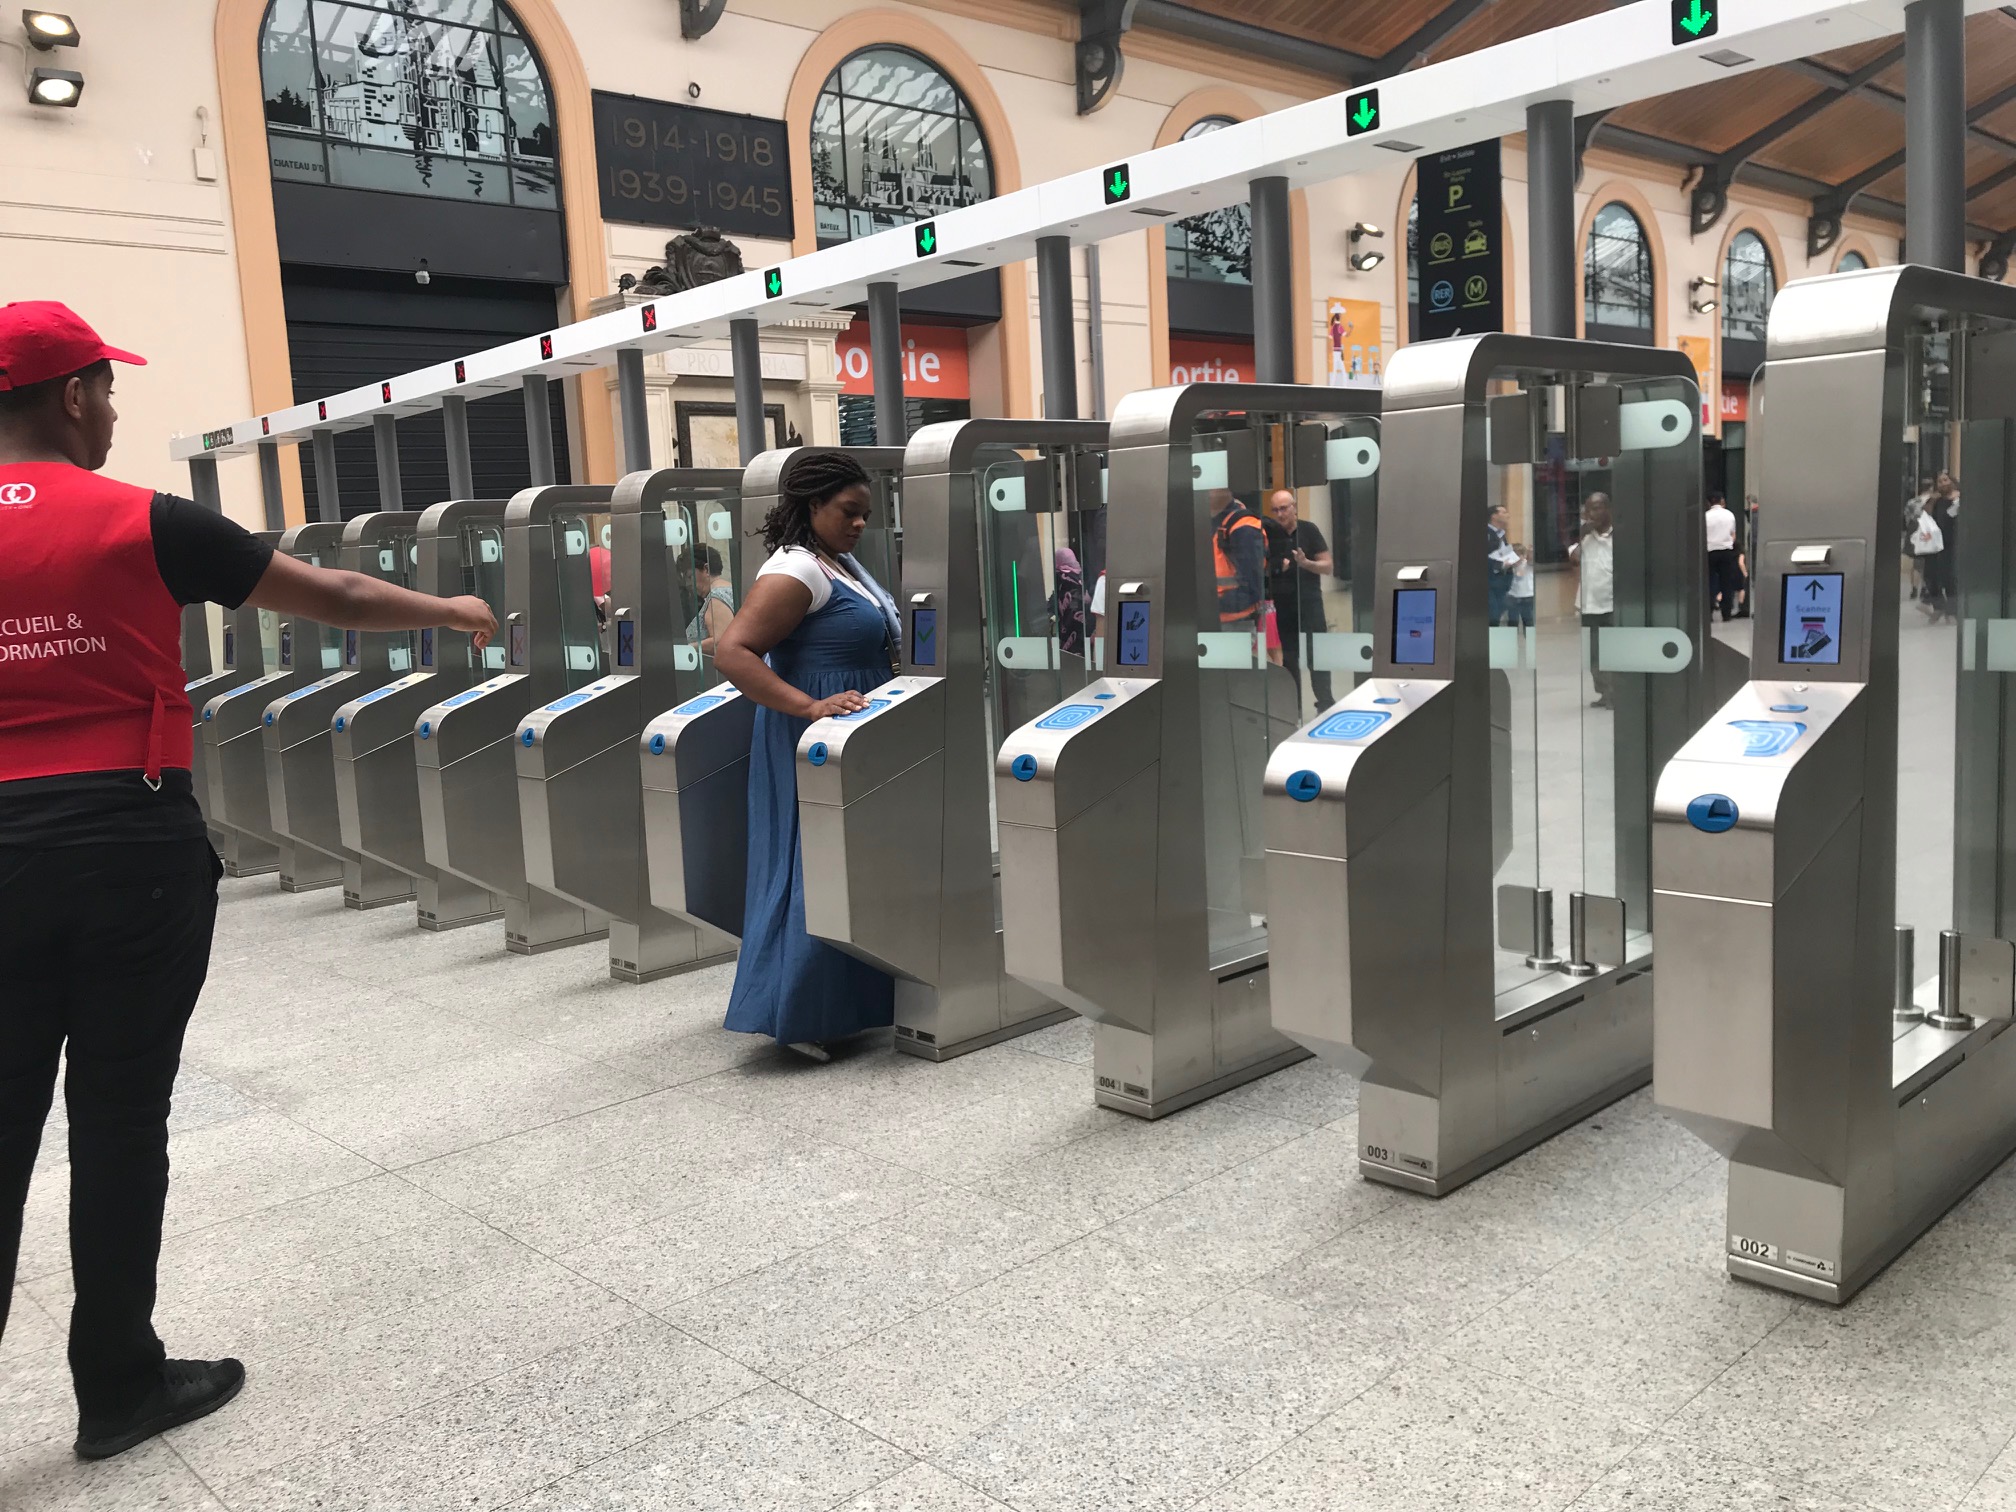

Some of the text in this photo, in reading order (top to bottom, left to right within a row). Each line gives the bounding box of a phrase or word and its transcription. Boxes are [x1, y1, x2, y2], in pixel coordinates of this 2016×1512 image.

[274, 159, 309, 171] CHATEAU
[1448, 185, 1464, 207] P
[820, 222, 839, 231] BAYEUX
[1434, 287, 1451, 300] RER
[1469, 280, 1483, 296] M
[687, 353, 720, 374] PRO
[1171, 357, 1240, 385] ortie
[1795, 604, 1832, 614] Scannez
[0, 613, 84, 637] CUEIL &
[0, 636, 107, 663] ORMATION
[1100, 1076, 1116, 1090] 004
[1367, 1145, 1388, 1161] 003
[1740, 1238, 1770, 1259] 002
